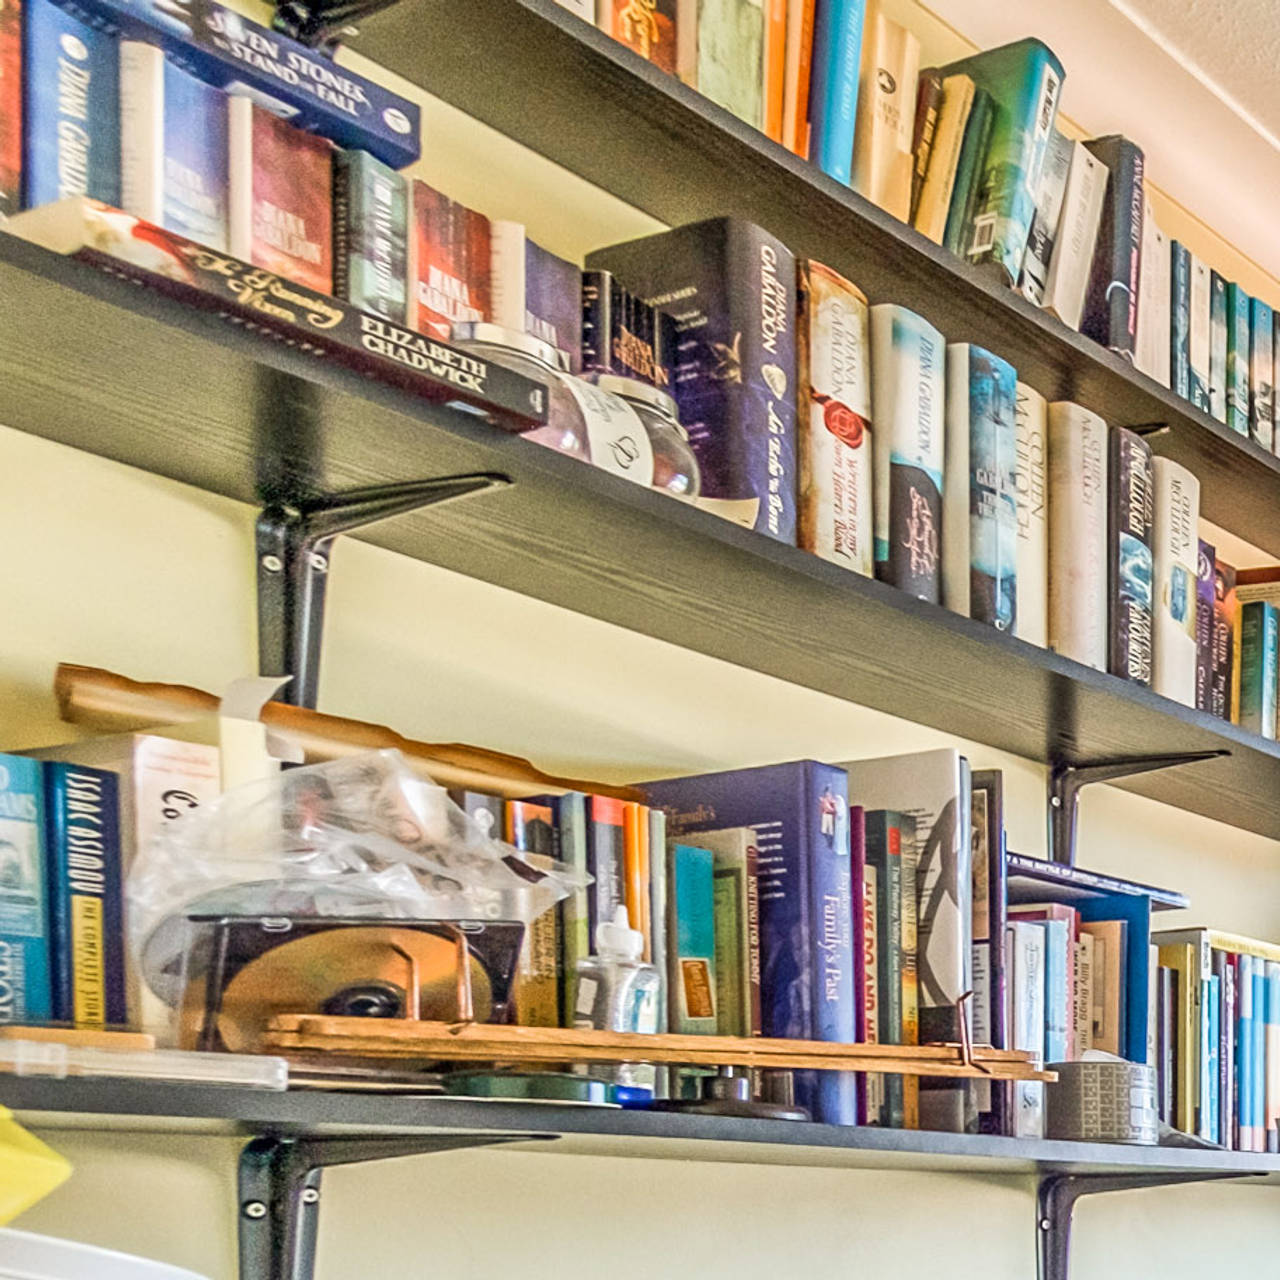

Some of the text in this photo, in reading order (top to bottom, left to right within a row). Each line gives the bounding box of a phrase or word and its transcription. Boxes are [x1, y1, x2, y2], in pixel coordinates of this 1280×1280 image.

[231, 42, 300, 86] STAND
[314, 82, 360, 117] FALL
[288, 50, 373, 110] STONES
[57, 56, 91, 200] DIANA GABALDO
[760, 244, 778, 355] GABALDON
[775, 282, 789, 333] DIANA
[359, 313, 488, 380] ELIZABETH
[360, 333, 486, 395] CHADWICK
[830, 302, 846, 398] GABALDON
[844, 329, 858, 387] DIANA
[916, 335, 935, 455] DIANA GABALDON
[847, 457, 859, 517] Written
[1029, 431, 1046, 521] COLLEEN
[1181, 494, 1191, 549] COLLEEN
[65, 771, 106, 895] ISAAC ASIMOV
[82, 899, 98, 920] THE
[81, 924, 100, 984] COMPLETE
[816, 894, 843, 1003] Family's Past
[1078, 987, 1090, 1022] Bragg
